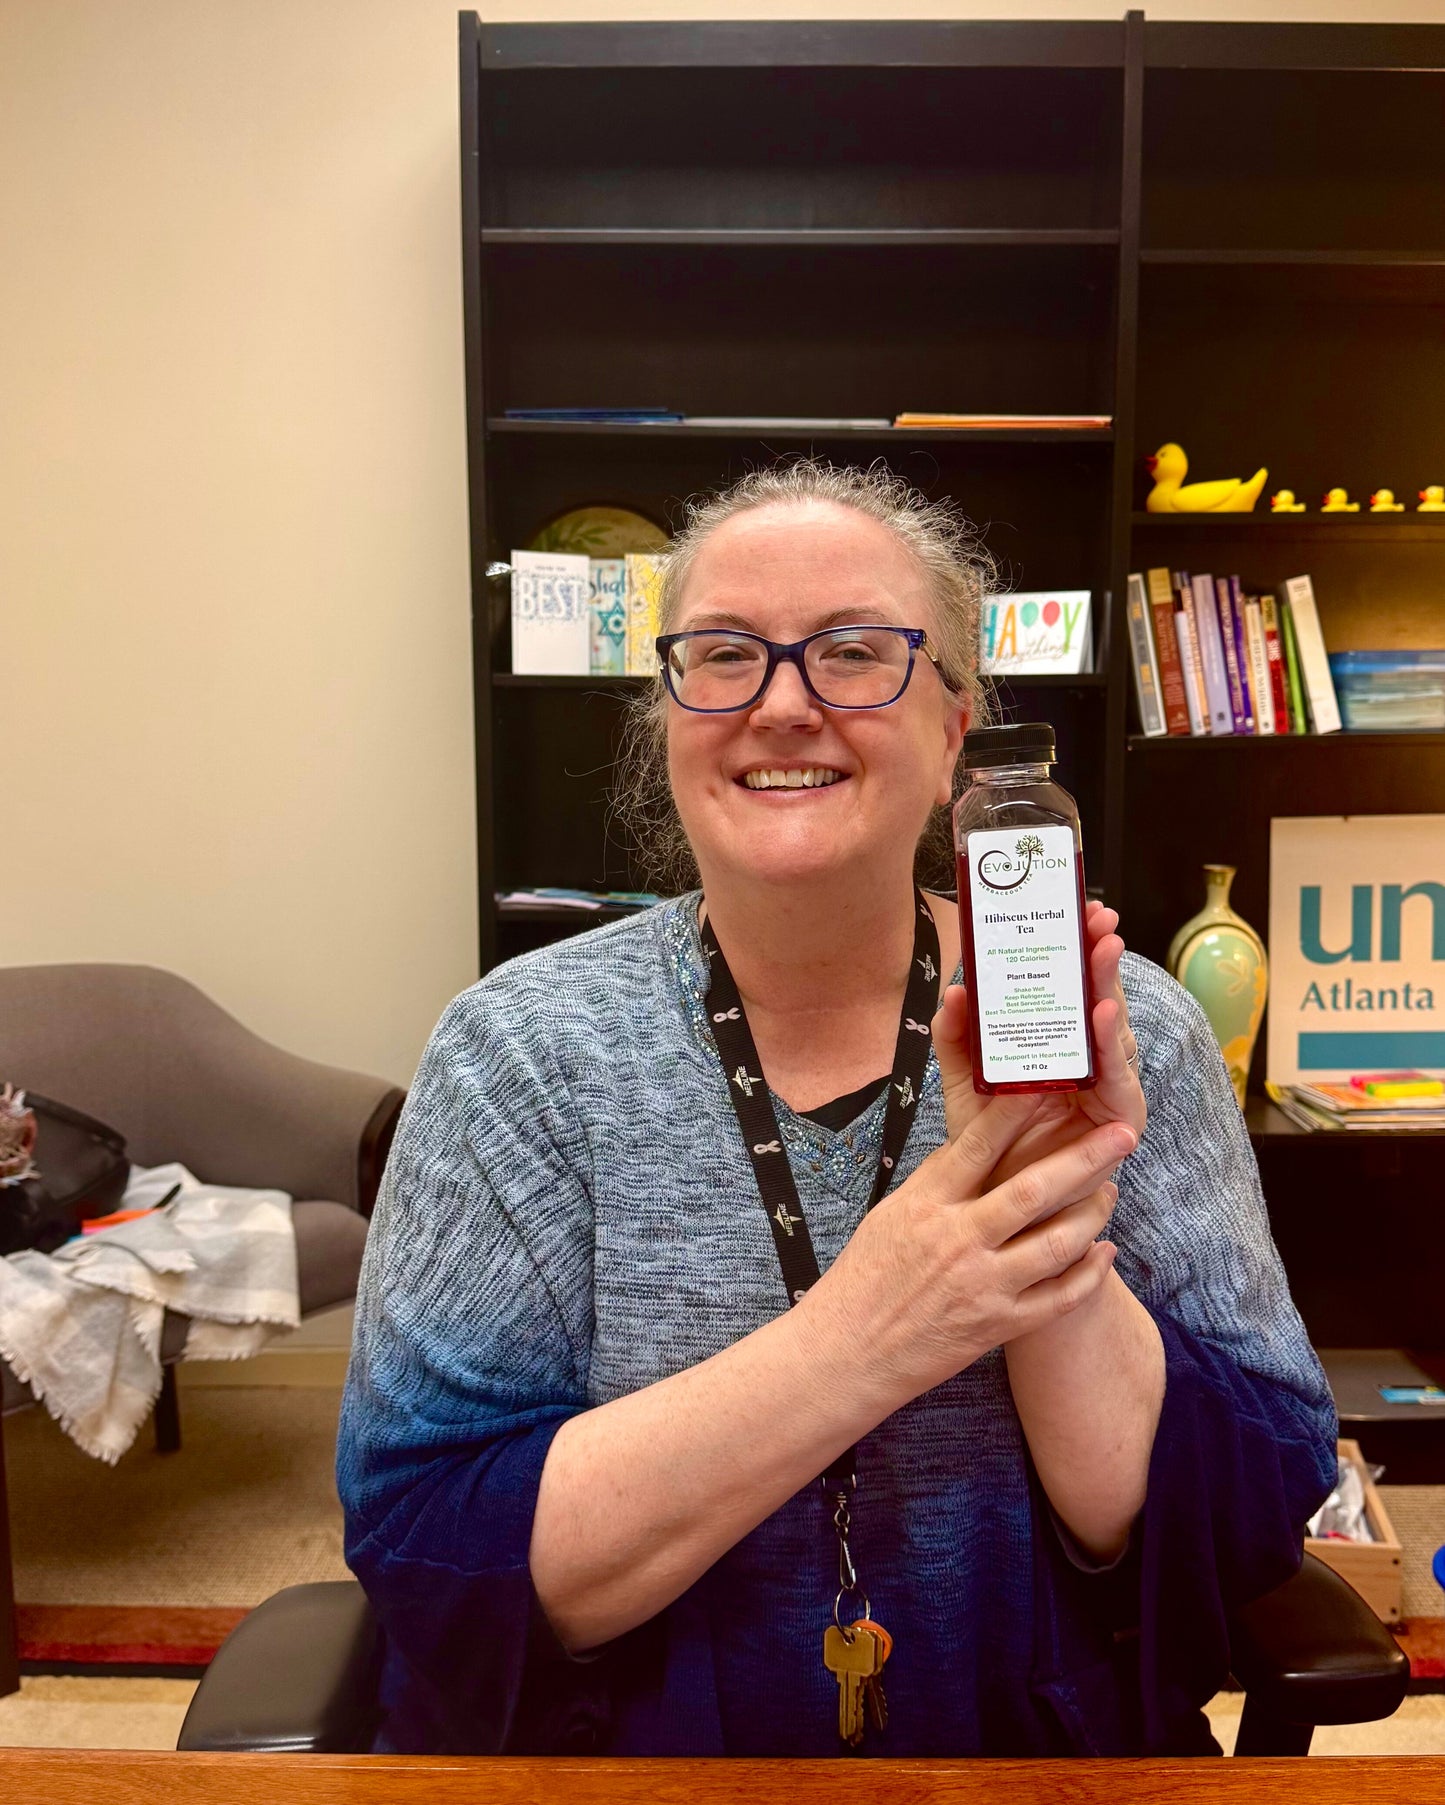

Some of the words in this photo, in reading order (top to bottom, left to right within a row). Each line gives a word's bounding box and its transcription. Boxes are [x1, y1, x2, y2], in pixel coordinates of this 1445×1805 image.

[518, 577, 585, 619] BEST
[983, 857, 1068, 874] EVOLUTION
[985, 913, 1028, 924] Hibiscus
[1030, 909, 1065, 921] Herbal
[1016, 924, 1034, 934] Tea
[998, 946, 1024, 955] Natural
[1025, 944, 1067, 955] Ingredients
[1019, 954, 1050, 962] Calories
[1027, 971, 1050, 980] Based
[1020, 992, 1055, 1001] Refrigerated
[1300, 979, 1435, 1012] Atlanta
[1007, 1007, 1034, 1015] Consume
[1016, 1021, 1034, 1029] you're
[989, 1028, 1024, 1036] redistributed
[1045, 1033, 1068, 1041] planet's
[1017, 1041, 1050, 1049] ecosystem!
[1004, 1054, 1030, 1062] Support
[1058, 1050, 1080, 1058] Health
[737, 1065, 753, 1097] MEDLINE
[899, 1075, 911, 1110] MEDLINE
[778, 1203, 795, 1237] MEDLINE
